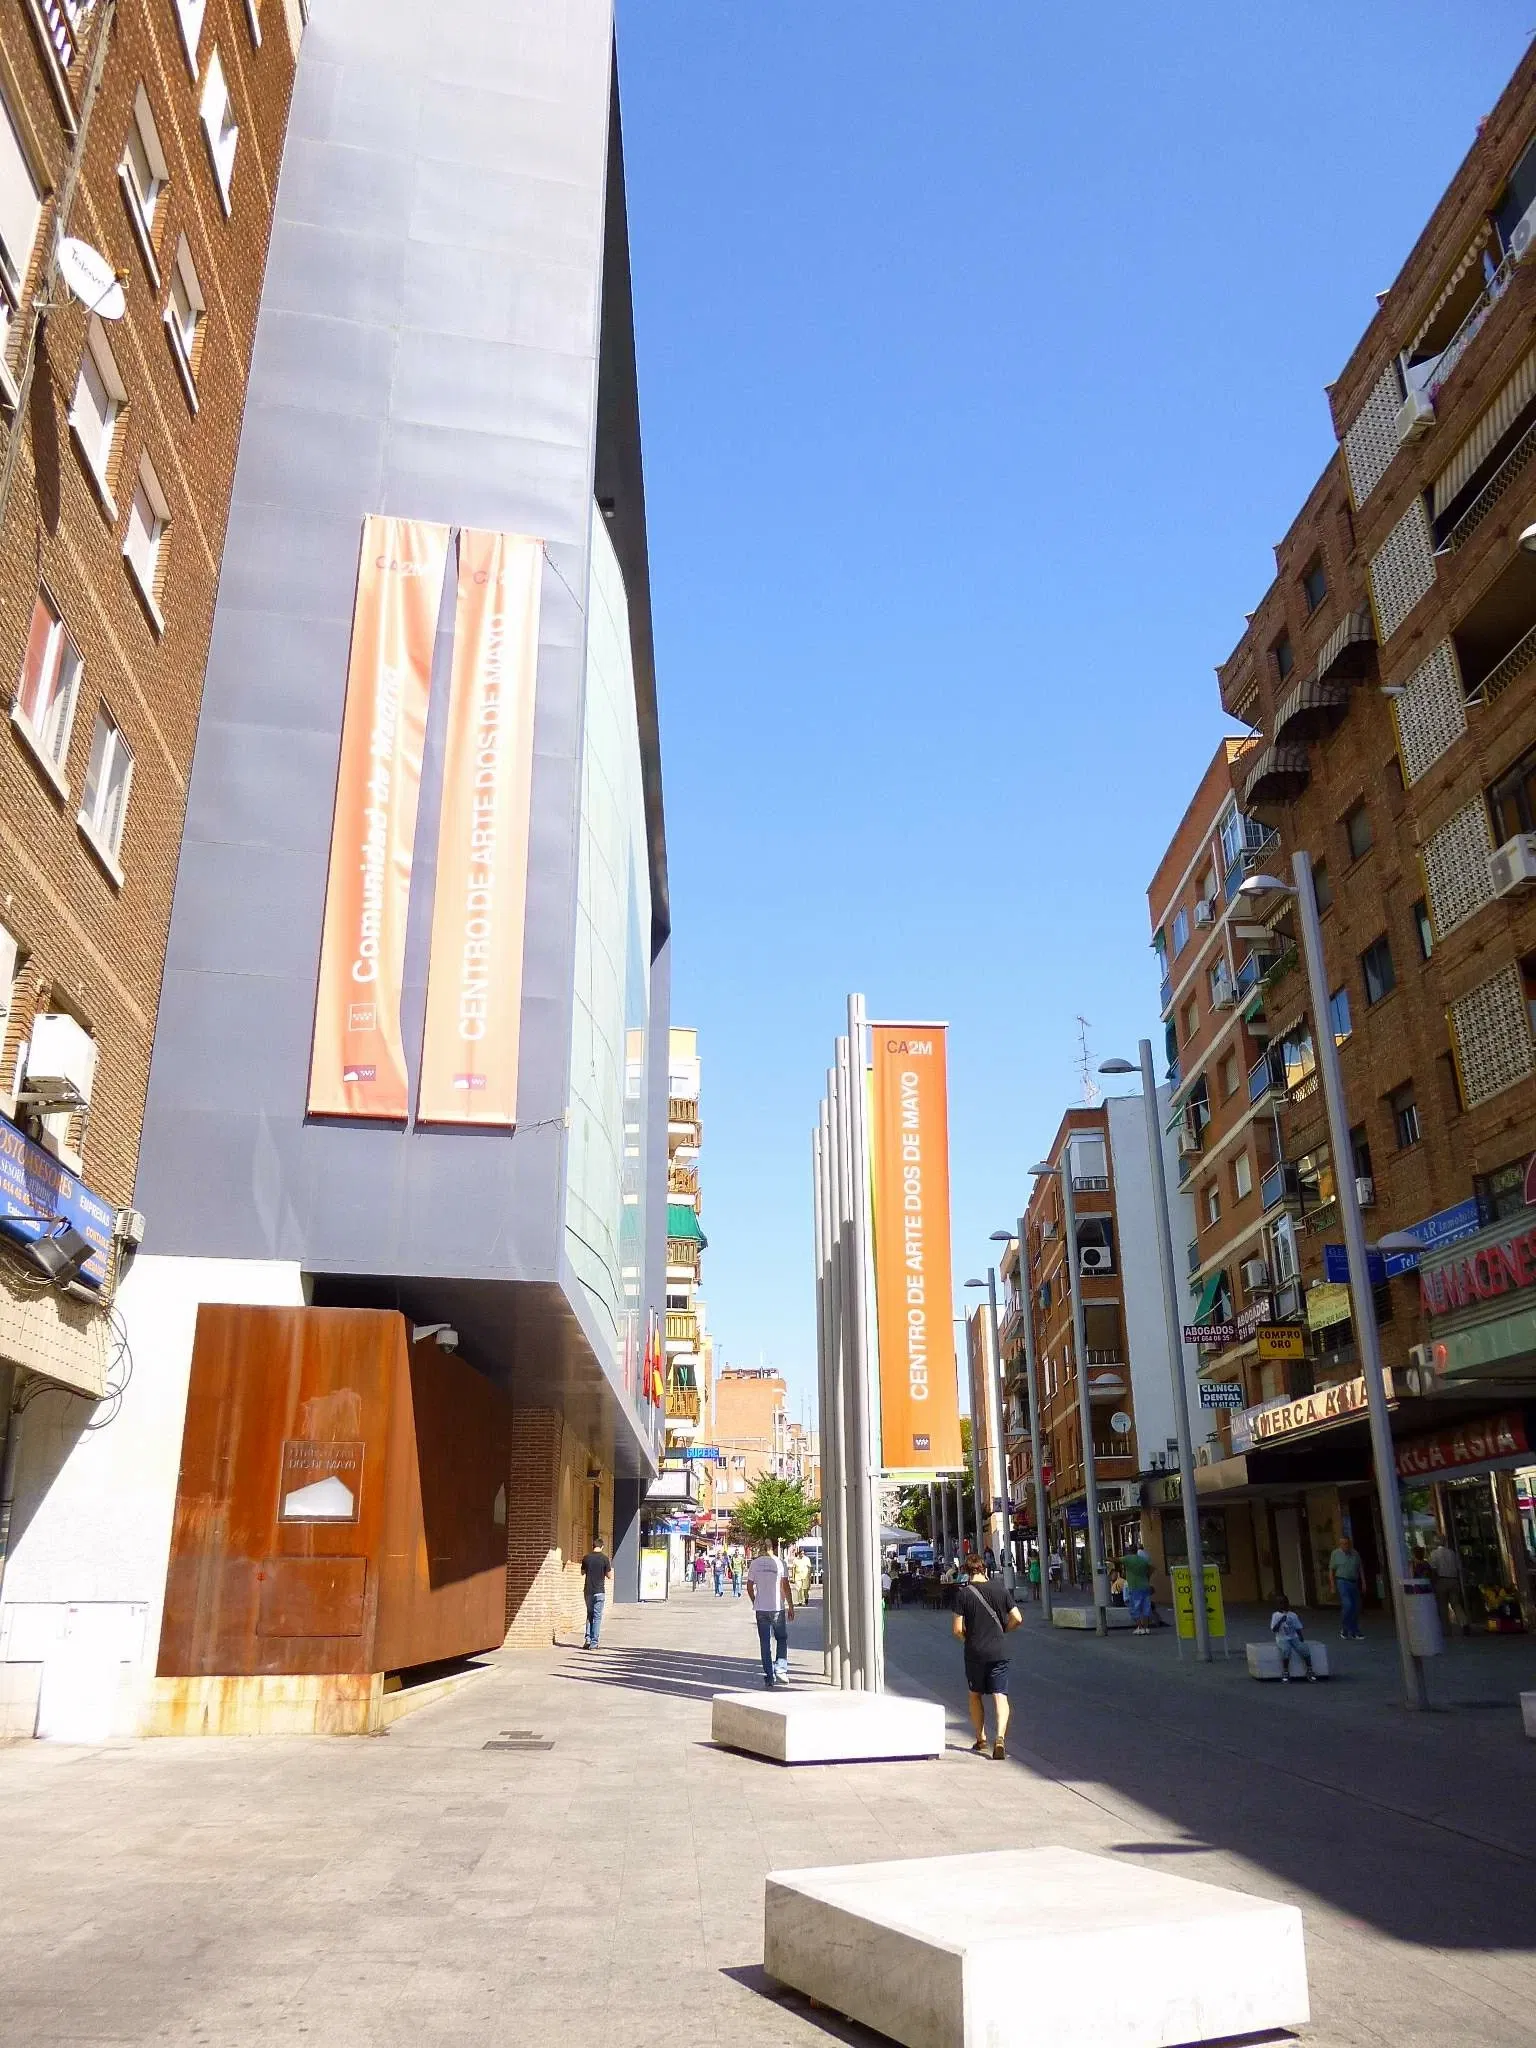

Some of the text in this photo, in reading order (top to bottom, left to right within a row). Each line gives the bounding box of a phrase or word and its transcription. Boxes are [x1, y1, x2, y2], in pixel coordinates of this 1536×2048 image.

[479, 688, 502, 725] DE
[474, 730, 500, 788] DOS
[471, 793, 498, 867] ARTE
[352, 808, 388, 983] Comunidad
[466, 871, 494, 911] DE
[459, 917, 491, 1041] CENTRO
[886, 1040, 932, 1055] CA2M
[80, 1195, 110, 1226] EMPRESAS
[900, 1070, 928, 1400] CENTRO DE ARTE DOS DE MAYO
[1185, 1325, 1234, 1336] ABOGADOS
[1259, 1330, 1300, 1339] COMPRO
[1270, 1340, 1292, 1349] ORO
[1258, 1400, 1318, 1438] MERCA
